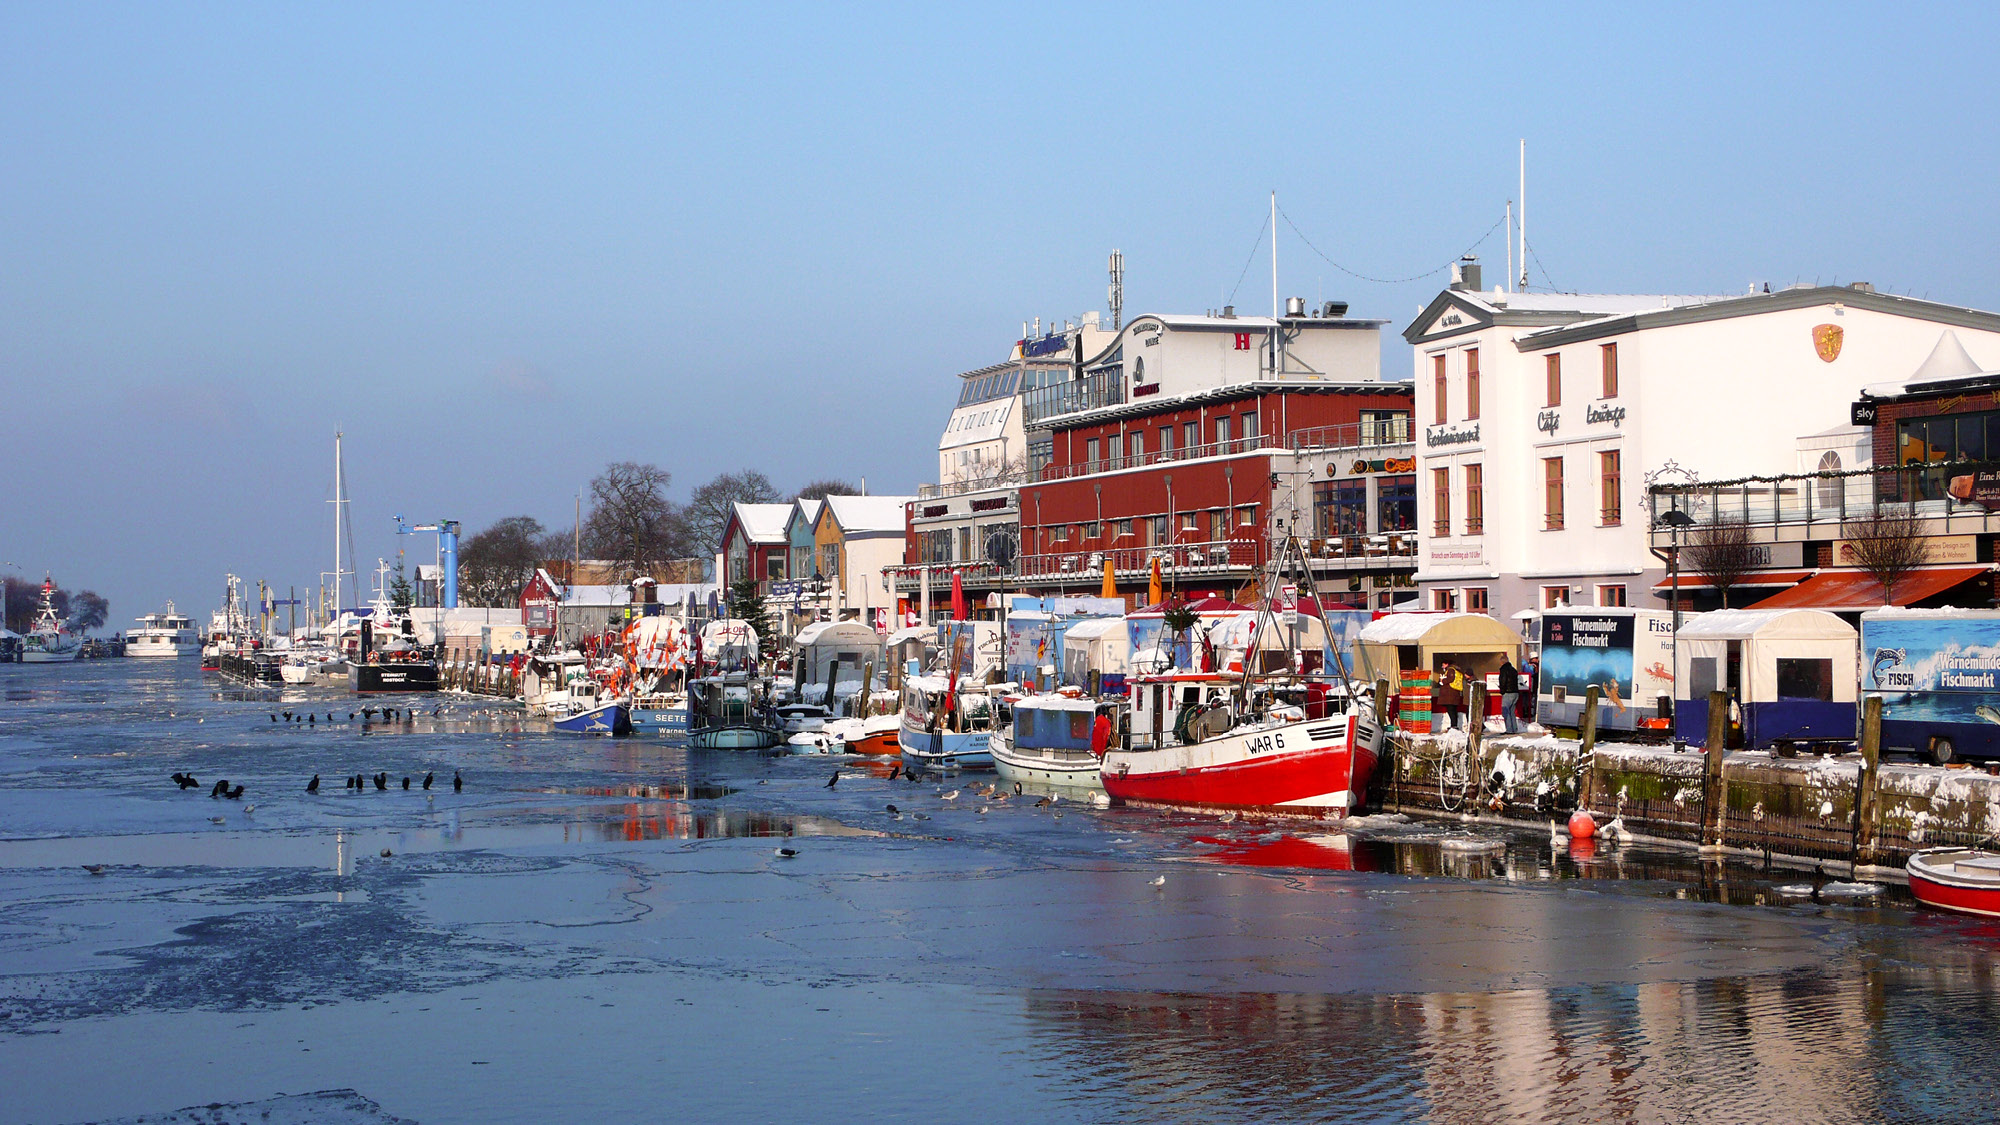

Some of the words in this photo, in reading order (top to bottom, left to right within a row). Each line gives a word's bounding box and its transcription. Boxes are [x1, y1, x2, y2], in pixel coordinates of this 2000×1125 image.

[1234, 333, 1250, 350] H
[1587, 404, 1625, 428] Lounge
[1856, 408, 1874, 420] sky
[1538, 410, 1560, 437] Café
[1426, 422, 1480, 448] Restaurant
[1979, 471, 1994, 480] Eine
[1943, 541, 1959, 551] Design
[1572, 618, 1618, 632] Warnemünder
[1649, 619, 1673, 633] Fisc
[1572, 633, 1609, 647] Fischmarkt
[1888, 673, 1914, 686] FISCH
[1941, 671, 1995, 688] Fischmarkt
[655, 714, 687, 722] SEETE
[1245, 736, 1274, 755] WAR
[1275, 733, 1285, 748] 6
